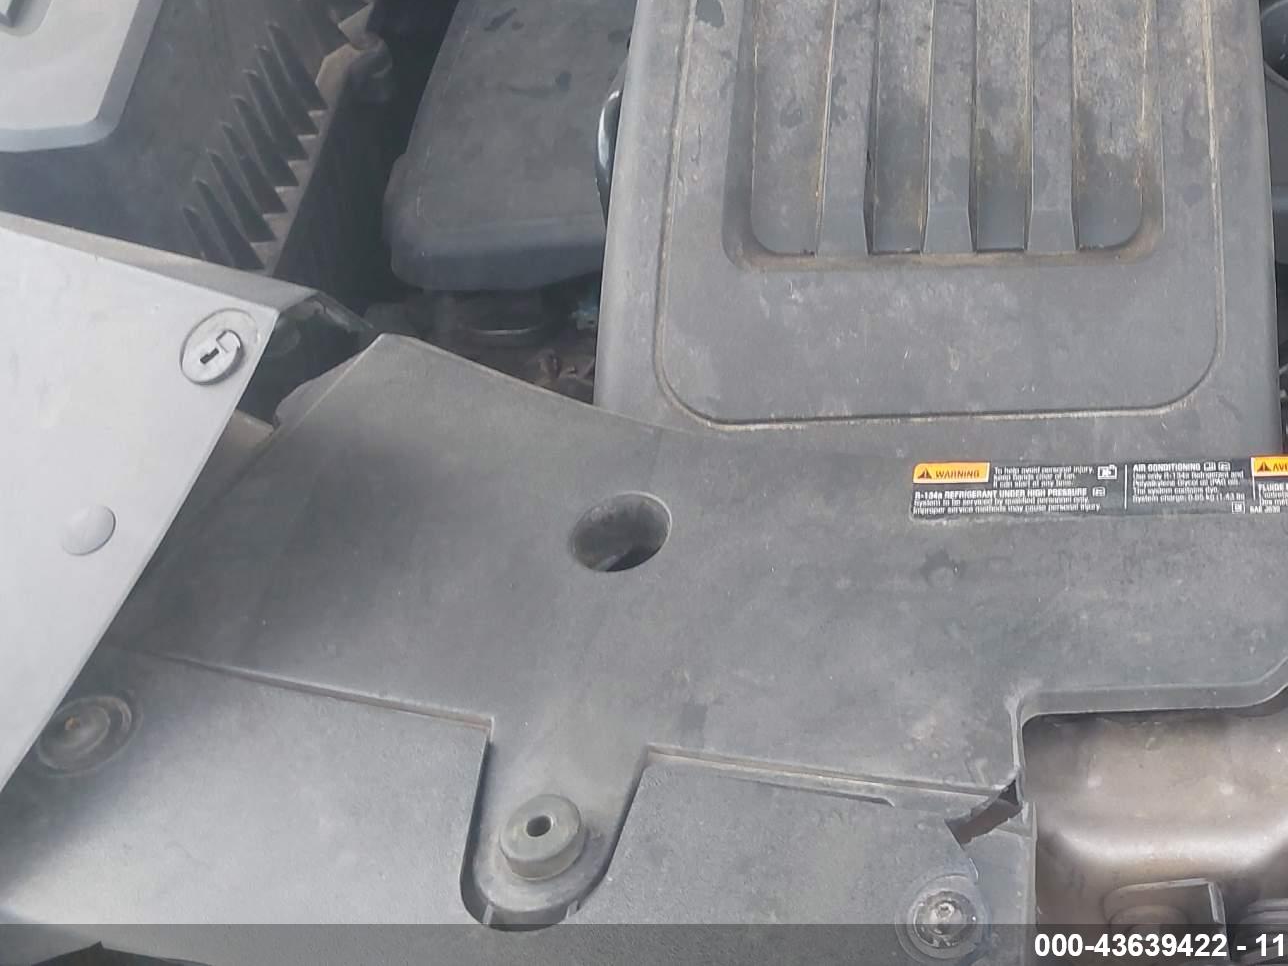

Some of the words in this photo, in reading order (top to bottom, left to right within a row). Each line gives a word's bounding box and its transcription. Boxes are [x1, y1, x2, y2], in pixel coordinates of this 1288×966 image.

[1042, 466, 1071, 475] personal
[1133, 464, 1146, 472] AIR
[1148, 463, 1201, 472] CONDITIONING
[936, 470, 980, 479] WARNING
[1258, 483, 1284, 492] FLUIDE
[915, 491, 943, 500] R-134a
[945, 490, 998, 499] REFRIGERANT
[999, 489, 1025, 498] UNDER
[1027, 489, 1046, 497] HIGH
[1048, 488, 1087, 497] PRESSURE
